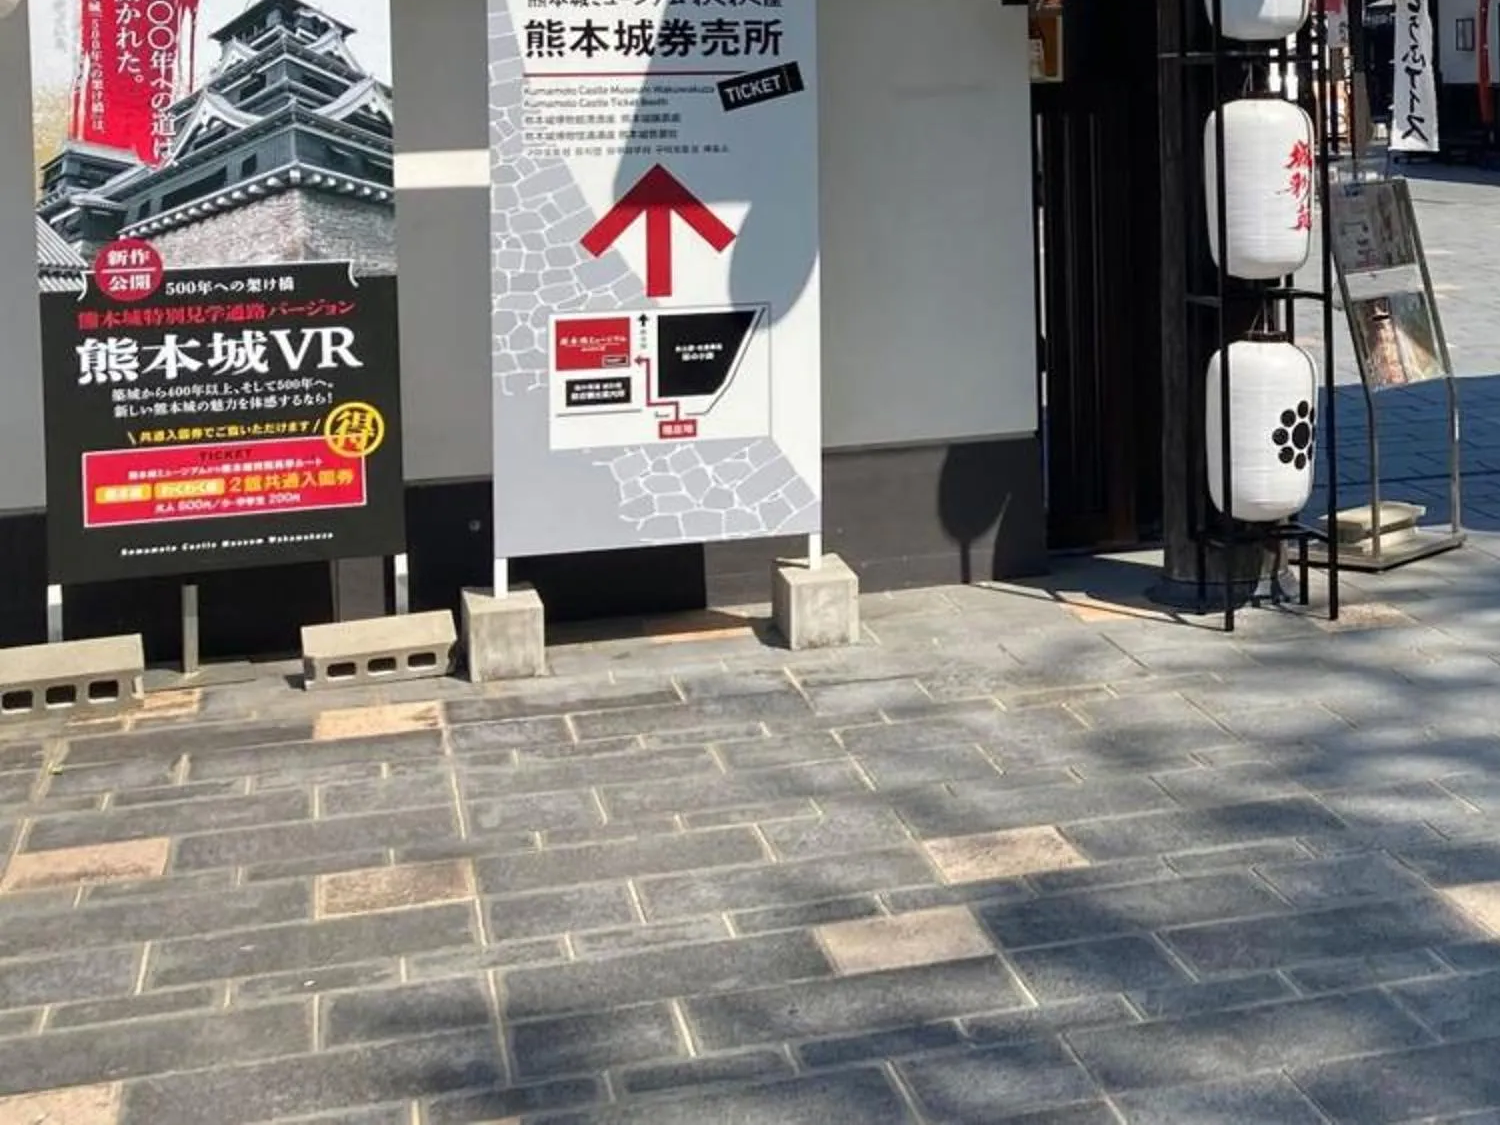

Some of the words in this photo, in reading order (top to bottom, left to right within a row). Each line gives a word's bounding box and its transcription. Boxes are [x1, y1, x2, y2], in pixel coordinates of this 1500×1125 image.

[523, 18, 785, 59] 熊本城券売所
[725, 74, 783, 104] TICKET
[106, 249, 151, 267] 新作
[107, 275, 152, 292] 公開
[164, 276, 295, 295] 500年への架け橋
[77, 300, 357, 330] 熊本城特別見学通路バージョン
[75, 325, 364, 385] 熊本城VR
[333, 410, 378, 452] 得
